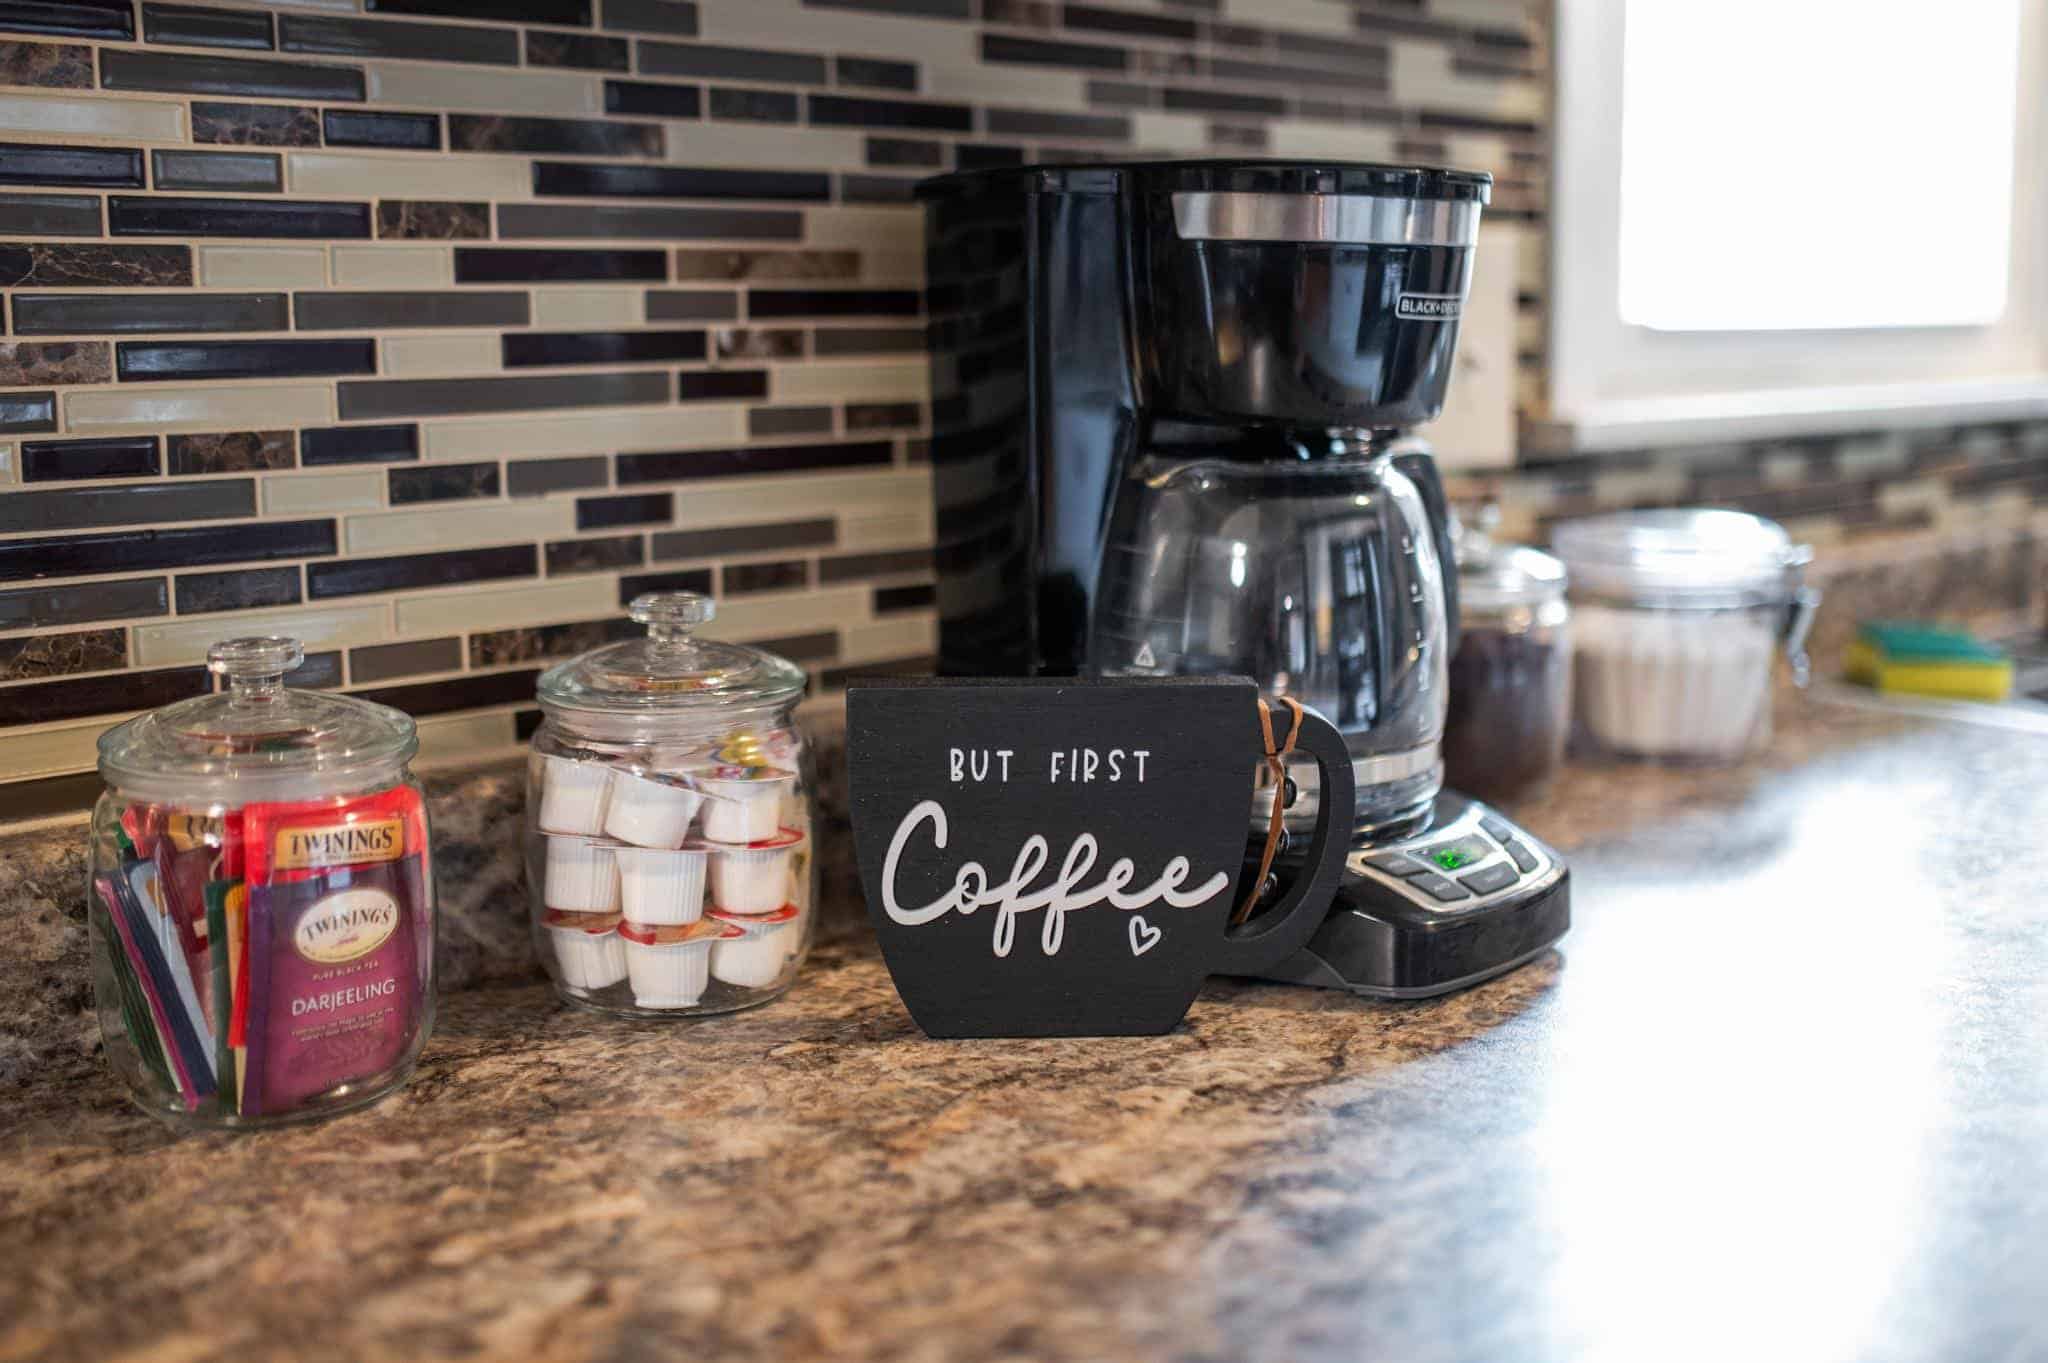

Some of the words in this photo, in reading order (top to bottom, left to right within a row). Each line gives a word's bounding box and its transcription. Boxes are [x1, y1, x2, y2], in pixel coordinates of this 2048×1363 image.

[950, 748, 1014, 783] BUT
[1050, 748, 1150, 784] FIRST
[290, 826, 393, 855] TWININGS
[881, 800, 1229, 957] Coffee
[304, 907, 391, 940] TWININGS
[291, 979, 396, 1016] DARJEELING
